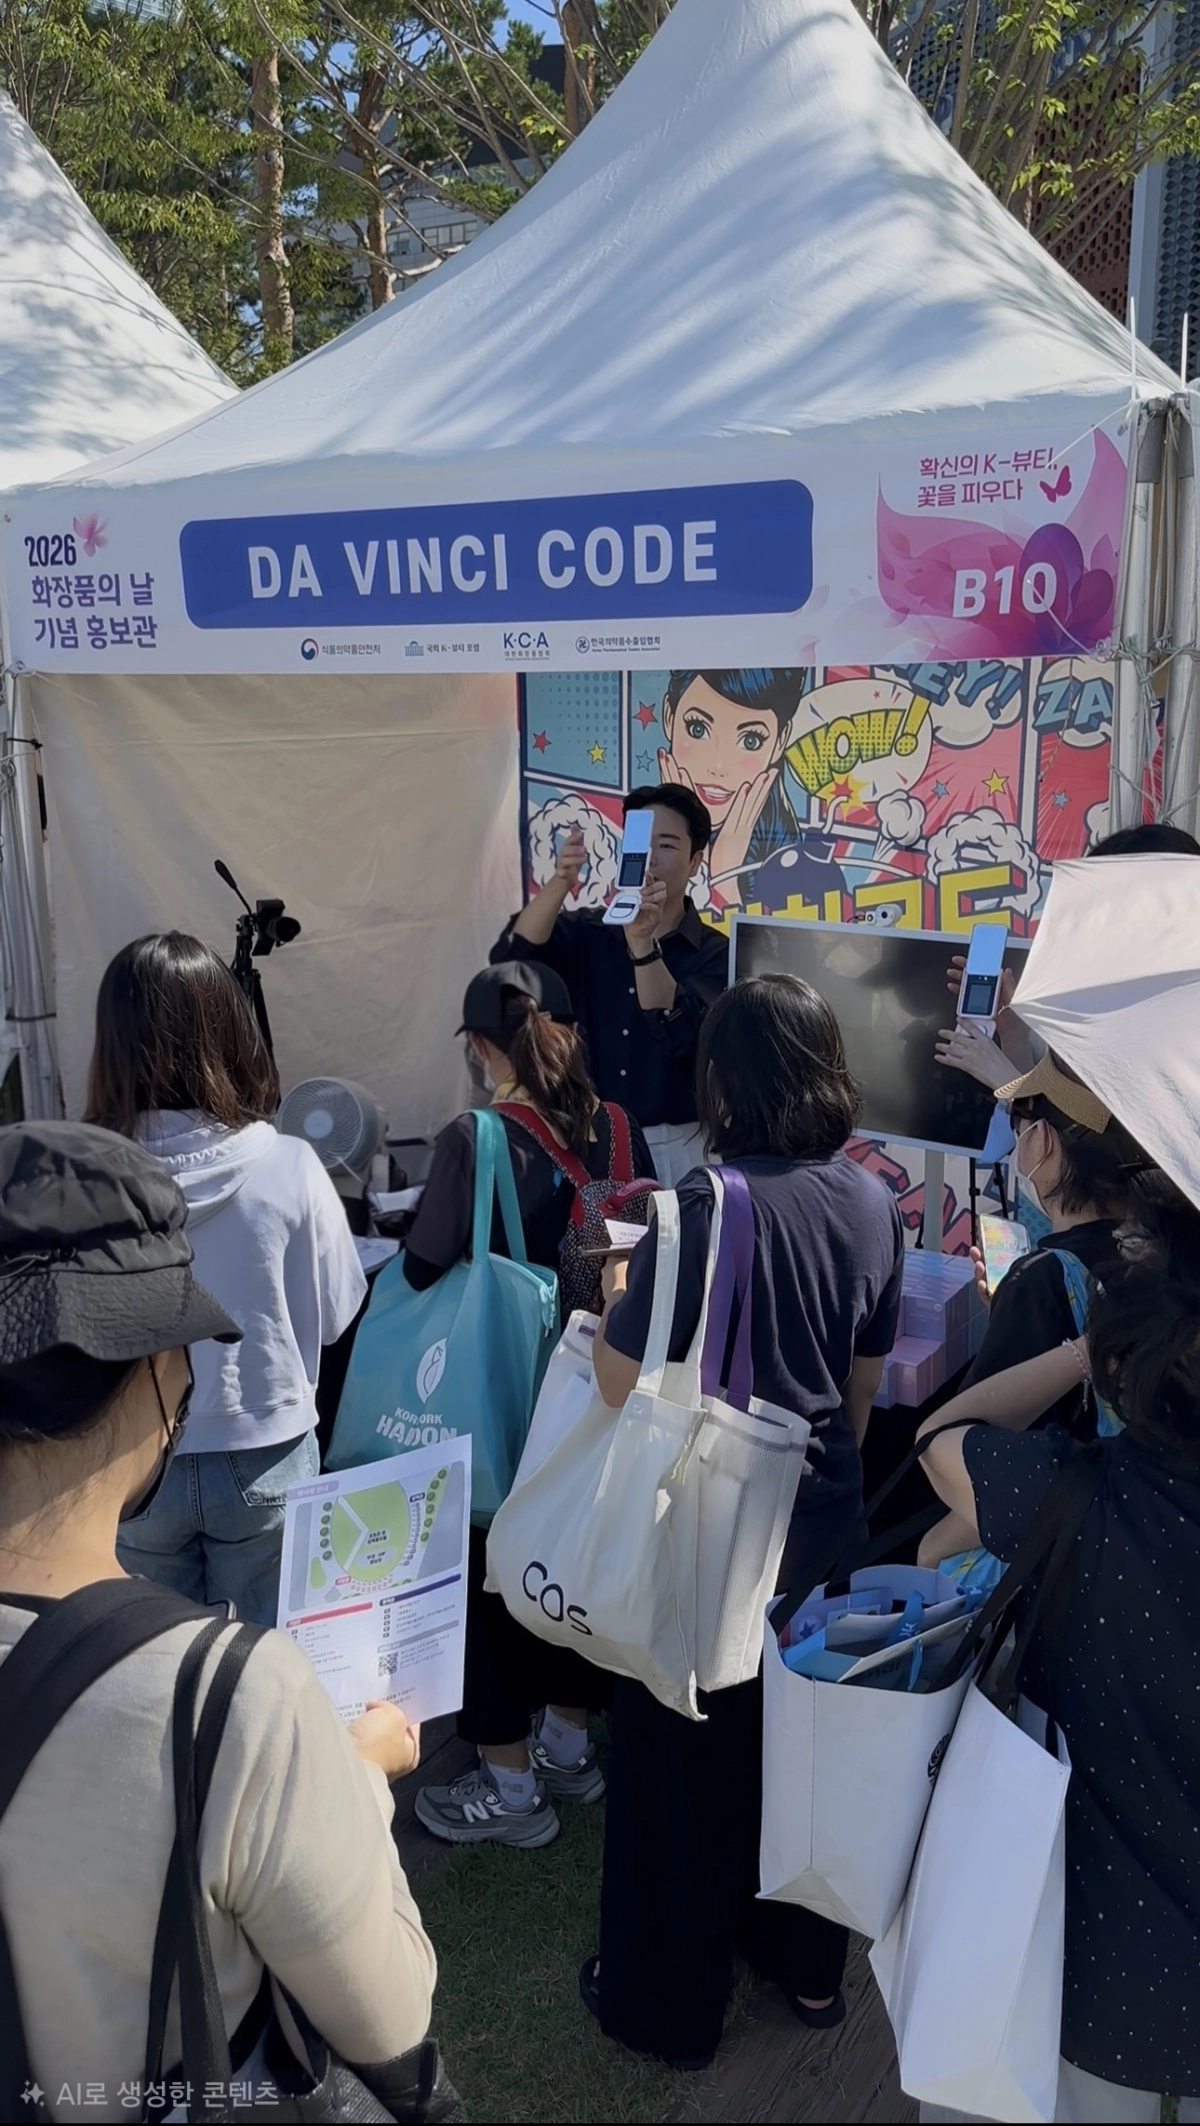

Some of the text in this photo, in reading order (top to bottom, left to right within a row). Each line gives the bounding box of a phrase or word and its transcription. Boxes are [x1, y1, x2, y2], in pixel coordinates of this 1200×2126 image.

[919, 454, 979, 479] 확신의
[917, 478, 1023, 508] 꽃을 피우다
[24, 534, 77, 567] 2026
[247, 520, 718, 599] DA VINCI CODE
[32, 572, 155, 608] 화장품의 날
[952, 562, 1057, 618] B10
[34, 615, 158, 650] 기념 홍보관
[785, 695, 931, 795] WOW!
